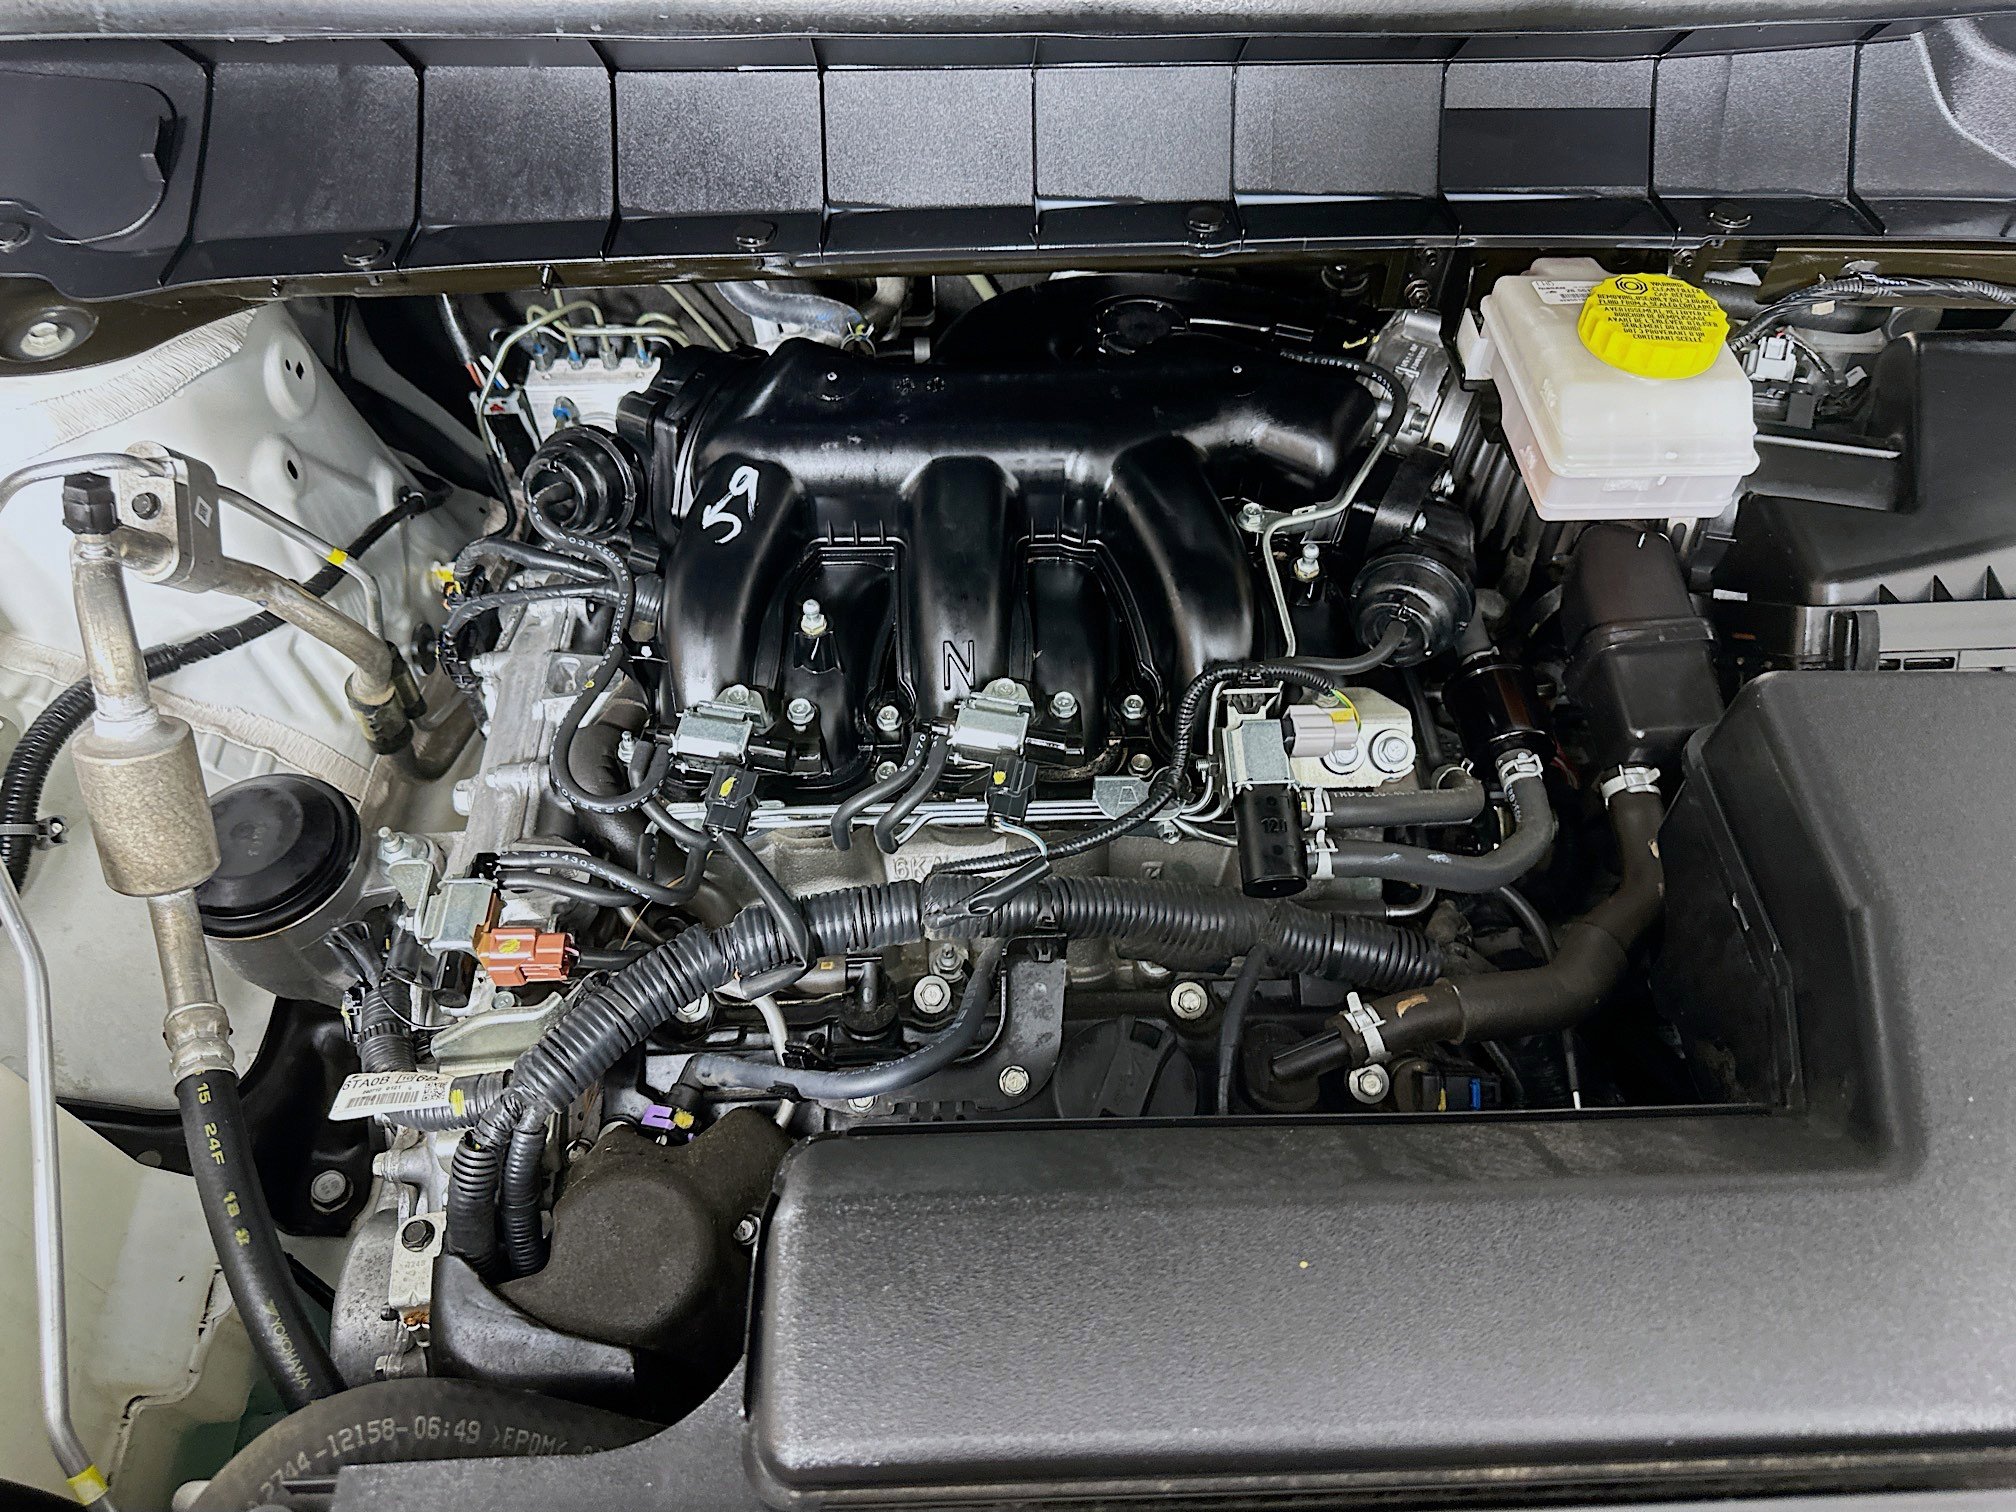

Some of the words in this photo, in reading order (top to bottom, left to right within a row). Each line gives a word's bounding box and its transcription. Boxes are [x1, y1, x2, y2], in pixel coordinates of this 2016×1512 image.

[196, 1082, 212, 1105] 15
[203, 1122, 226, 1165] 24F
[270, 1316, 312, 1390] YOKOHAMA
